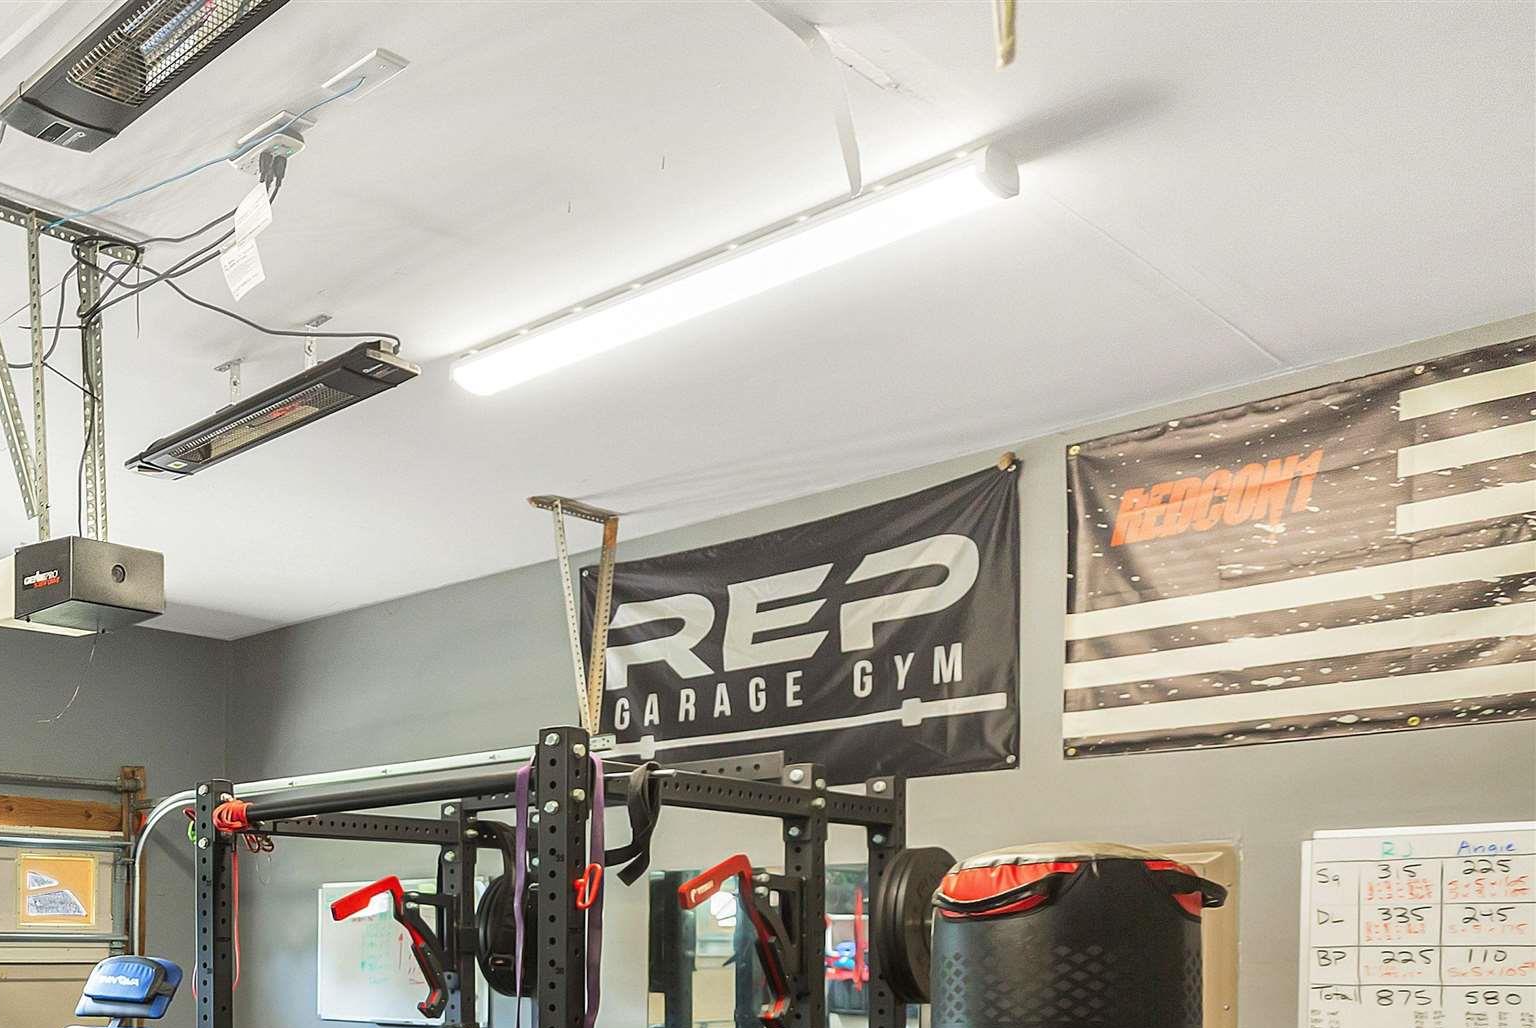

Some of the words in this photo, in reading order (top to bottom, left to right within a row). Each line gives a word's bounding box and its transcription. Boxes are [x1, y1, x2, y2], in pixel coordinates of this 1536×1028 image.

[1110, 448, 1324, 547] REDCON1
[605, 534, 980, 690] REP
[614, 670, 804, 731] GARAGE
[852, 642, 964, 698] GYM
[1377, 864, 1423, 879] 315
[1463, 859, 1513, 875] 225
[1377, 906, 1433, 924] 335
[1317, 949, 1347, 967] BP
[1381, 948, 1435, 965] 225
[1468, 949, 1508, 963] 110
[1311, 985, 1358, 1002] Total
[1376, 989, 1433, 1007] 875
[1465, 990, 1522, 1006] 580
